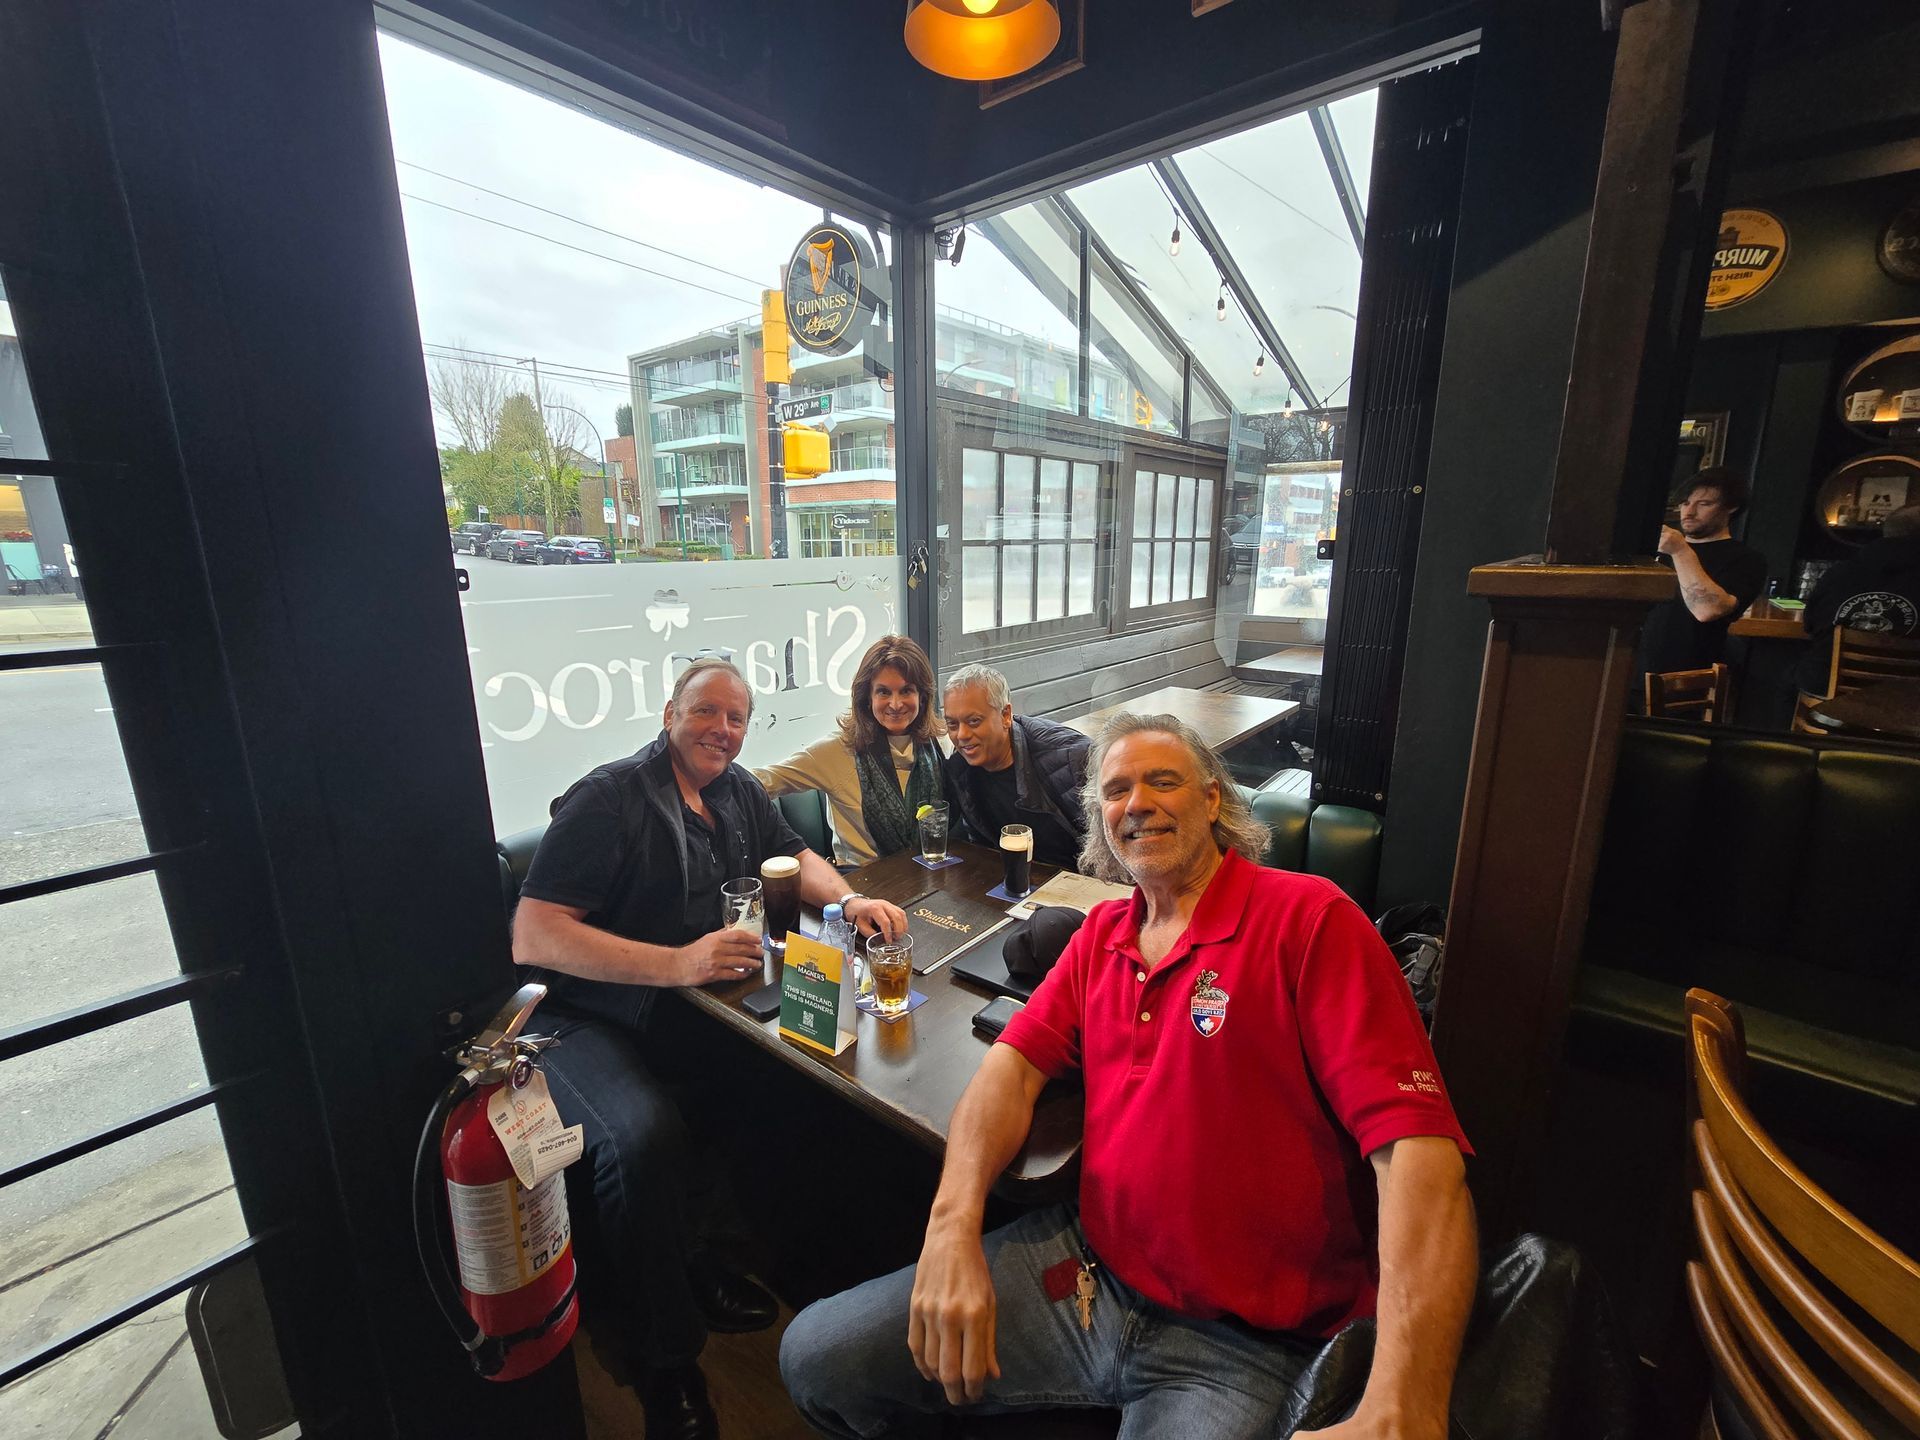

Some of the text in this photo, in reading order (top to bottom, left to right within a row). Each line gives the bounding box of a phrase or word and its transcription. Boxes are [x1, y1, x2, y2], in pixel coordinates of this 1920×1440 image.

[796, 293, 848, 316] GUINNESS
[783, 400, 820, 420] W 29th Ave
[913, 908, 971, 933] Shamrock
[797, 965, 825, 982] MAGNERS
[784, 990, 798, 1001] THIS
[804, 999, 835, 1016] MAGNERS.
[786, 984, 834, 1008] THIS IS IRELAND.
[1397, 1082, 1416, 1092] San
[1412, 1070, 1435, 1083] RWC
[504, 1119, 525, 1135] WEST
[525, 1102, 547, 1121] COAST
